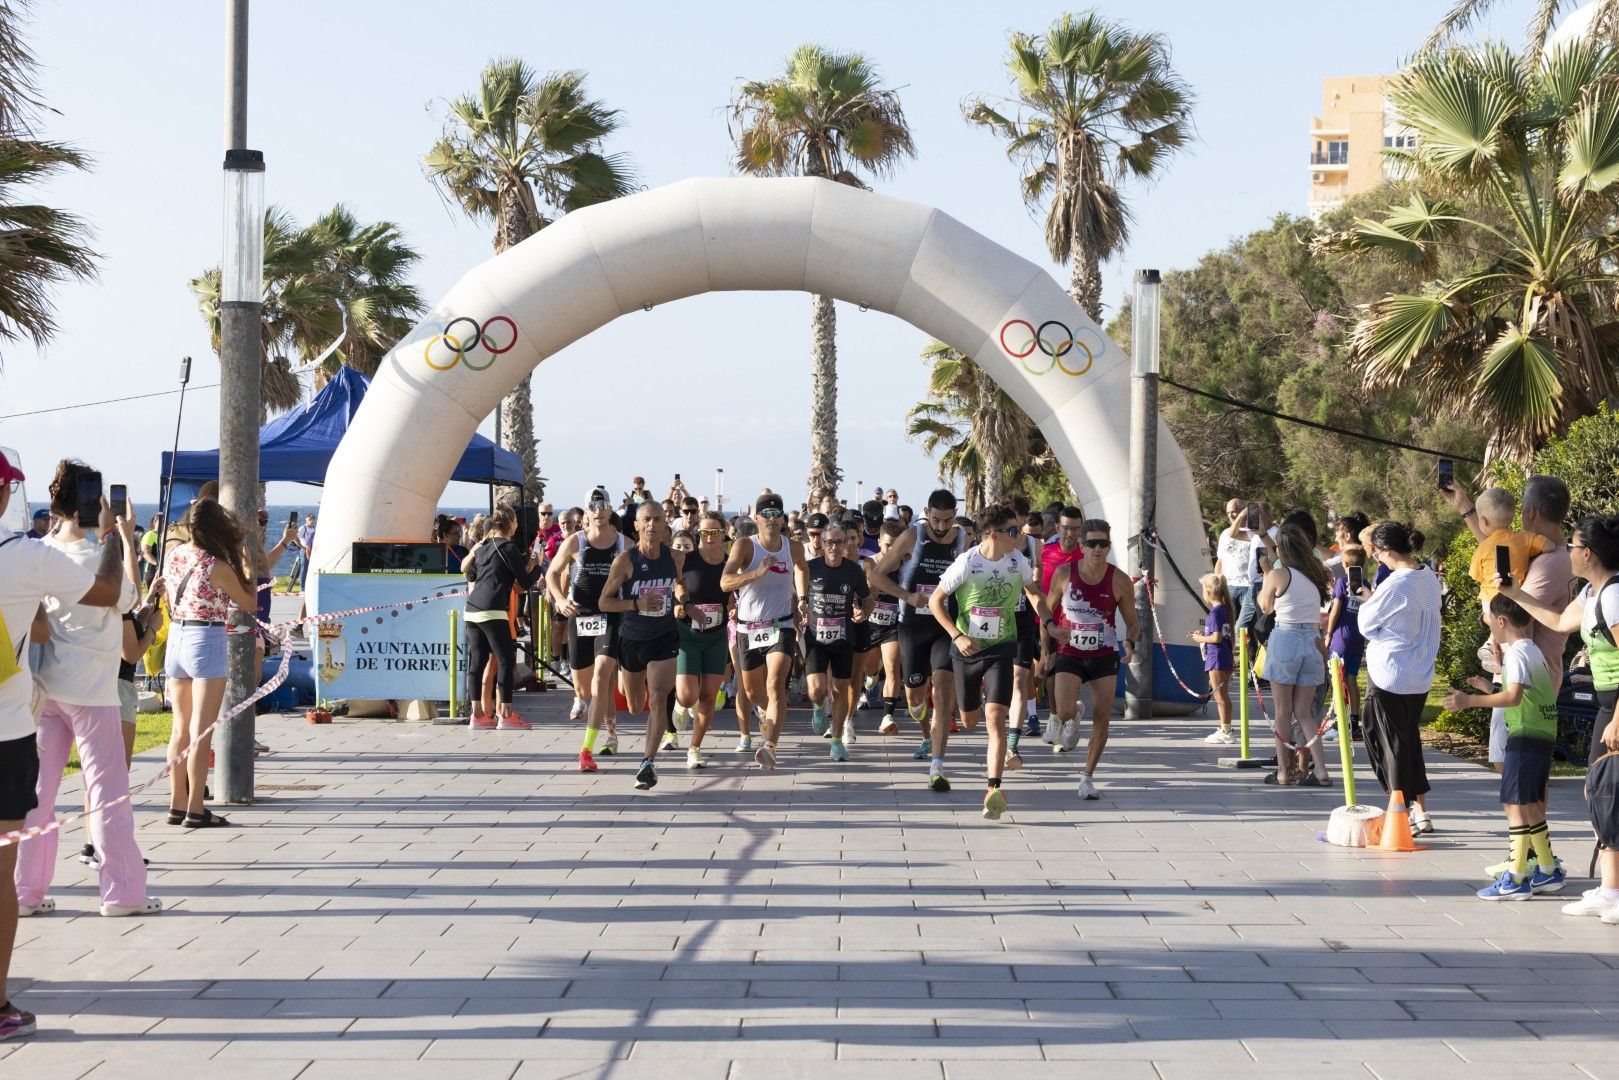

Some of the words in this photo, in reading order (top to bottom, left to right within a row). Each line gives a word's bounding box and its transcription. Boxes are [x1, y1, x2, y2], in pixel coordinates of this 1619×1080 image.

[872, 612, 890, 621] 182
[579, 621, 600, 631] 102
[979, 622, 989, 632] 4
[754, 632, 770, 643] 46
[819, 630, 839, 640] 187
[1073, 634, 1097, 645] 170
[355, 657, 378, 670] DE
